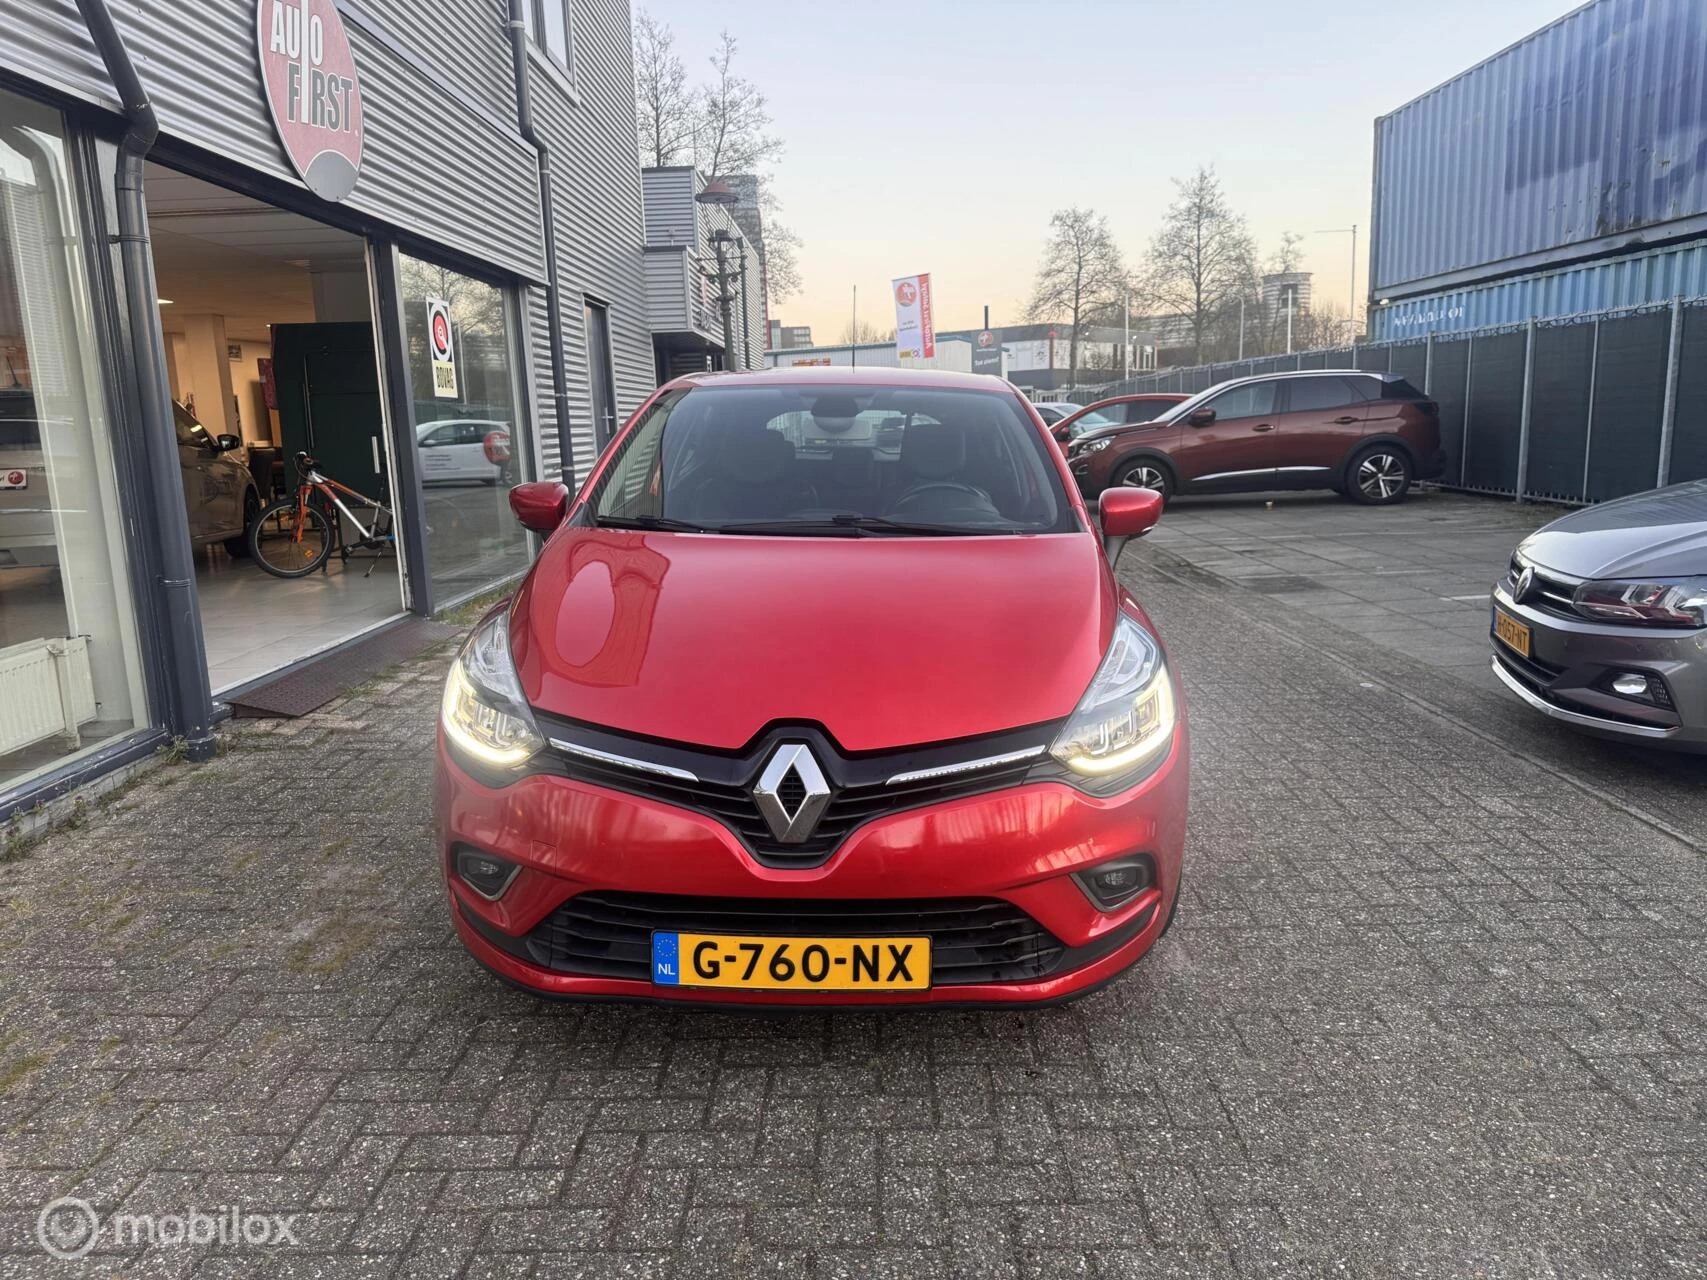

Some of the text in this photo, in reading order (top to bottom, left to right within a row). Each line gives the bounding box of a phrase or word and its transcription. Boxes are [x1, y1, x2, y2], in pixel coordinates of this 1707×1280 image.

[270, 0, 323, 65] AUTO
[287, 61, 353, 133] FIRST
[658, 963, 676, 976] NL
[693, 940, 914, 982] G-760-NX
